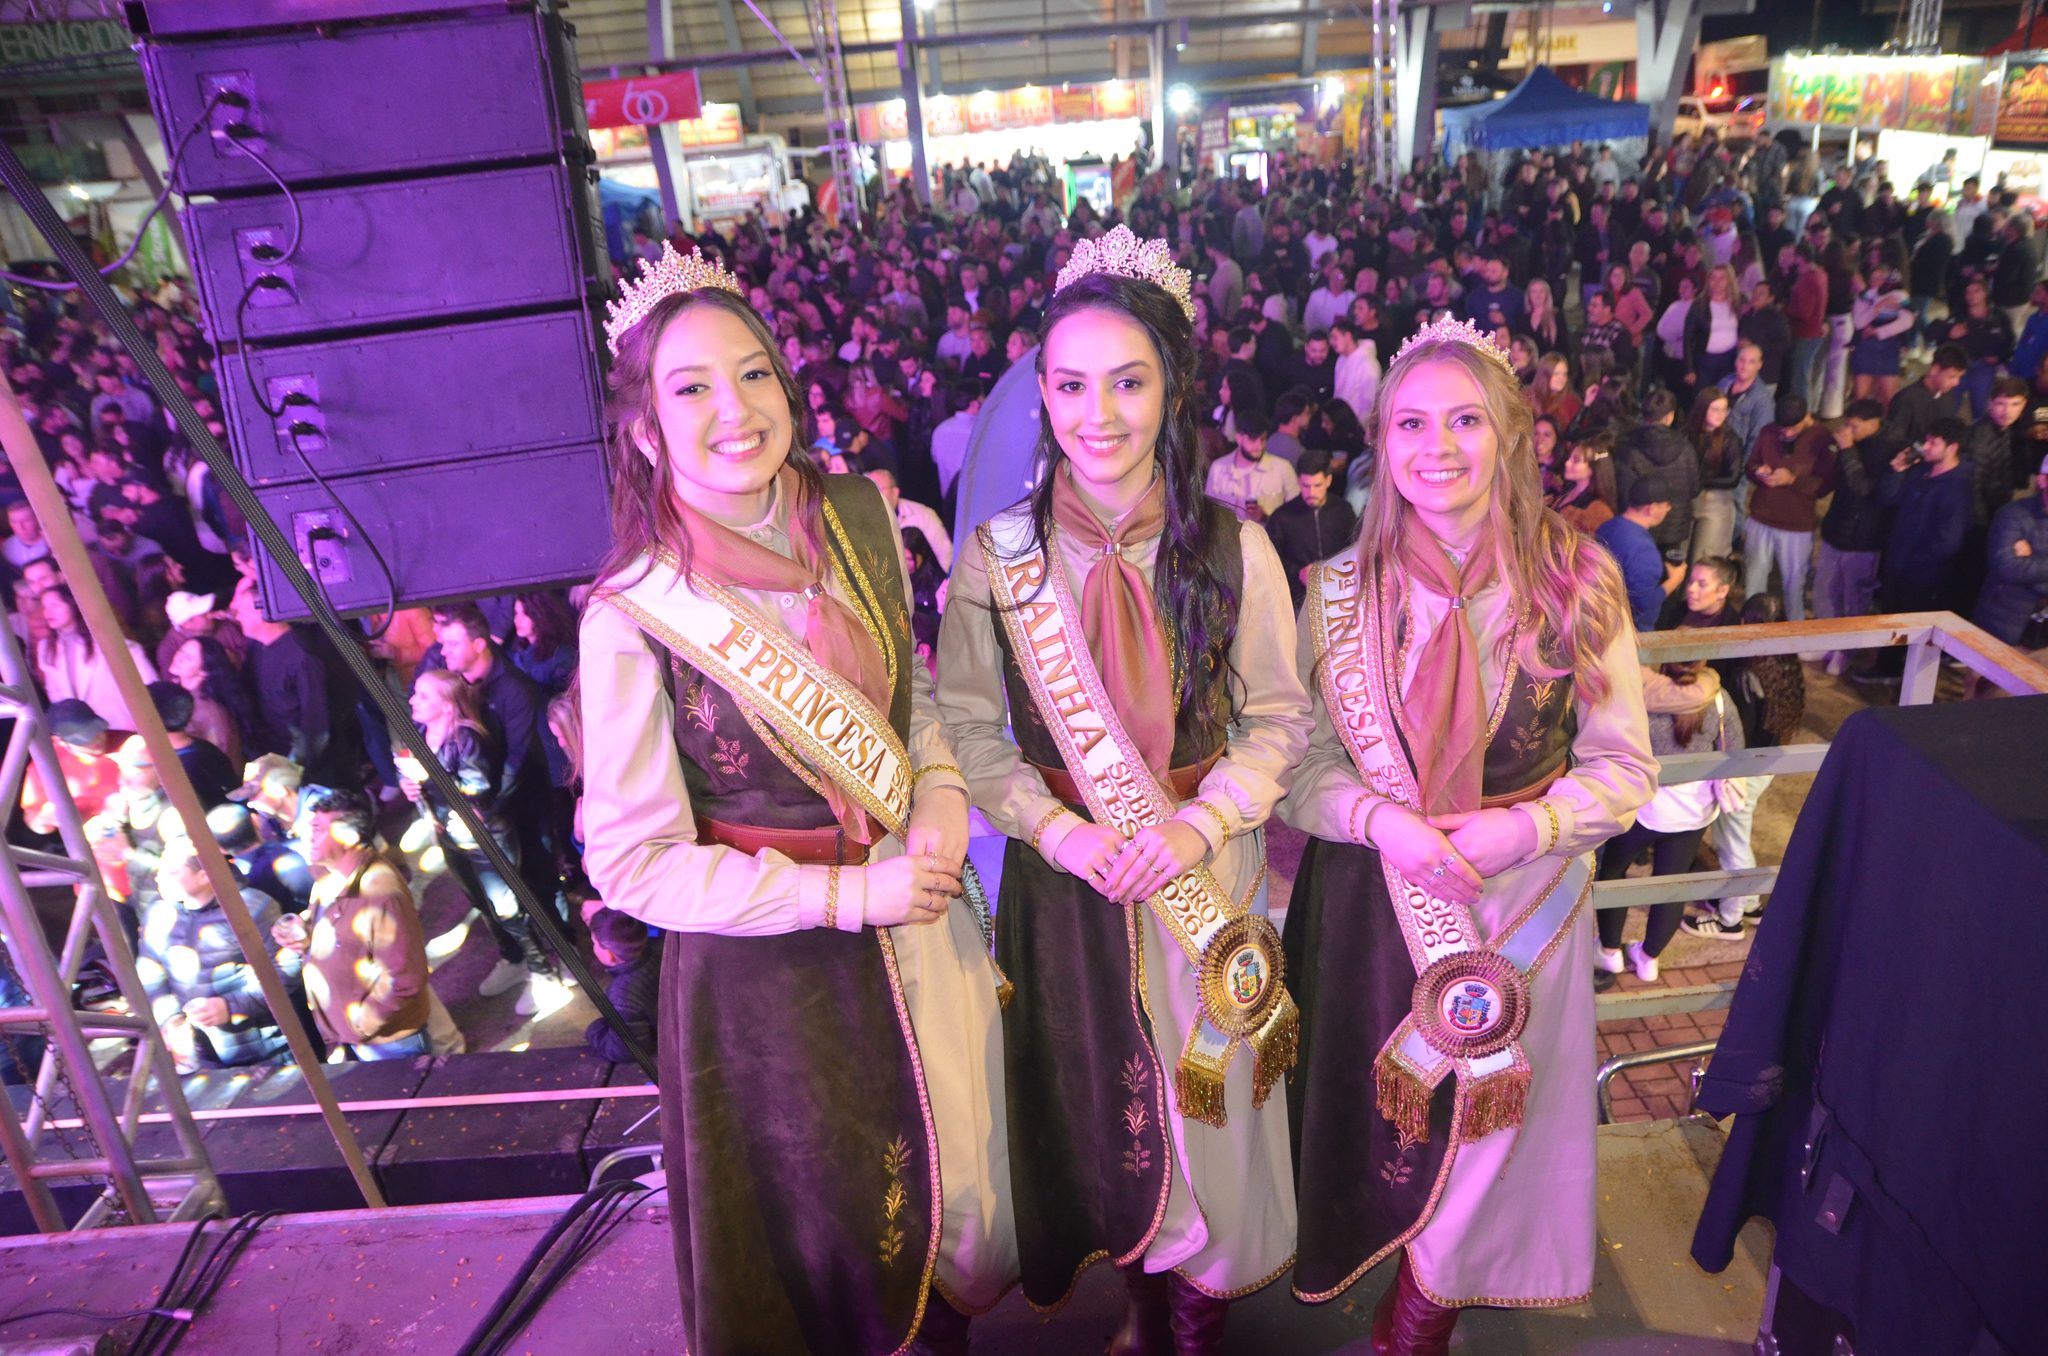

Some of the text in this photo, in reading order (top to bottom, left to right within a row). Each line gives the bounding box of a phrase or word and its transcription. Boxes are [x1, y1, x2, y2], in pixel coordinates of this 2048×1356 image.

[738, 640, 888, 788] PRINCESA
[1000, 551, 1110, 760] RAINHA
[1324, 597, 1384, 755] PRINCESA
[1089, 767, 1204, 936] FES 026
[1107, 761, 1219, 923] SEBE GRO
[1428, 895, 1464, 944] GRO
